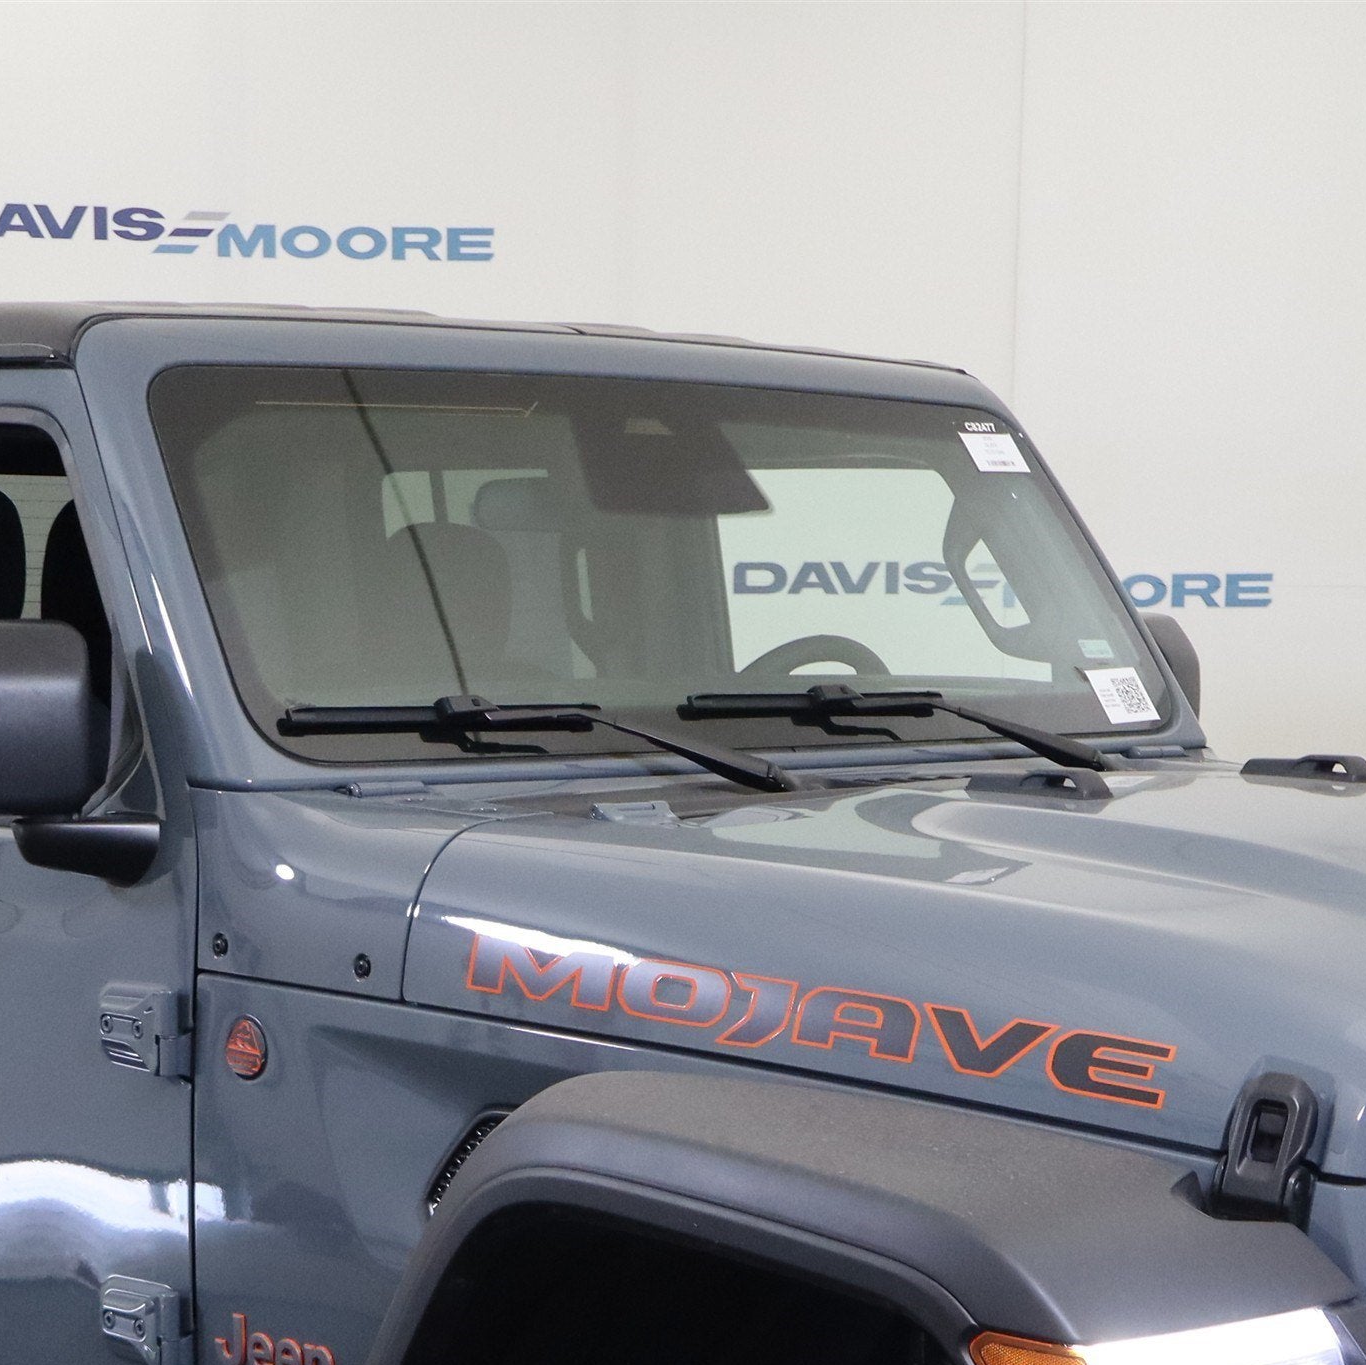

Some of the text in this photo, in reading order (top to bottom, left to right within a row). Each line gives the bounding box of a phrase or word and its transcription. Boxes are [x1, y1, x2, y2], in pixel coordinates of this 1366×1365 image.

[216, 222, 496, 263] MOORE
[732, 560, 955, 596] DAVIS
[464, 931, 1178, 1110] MOJAVE
